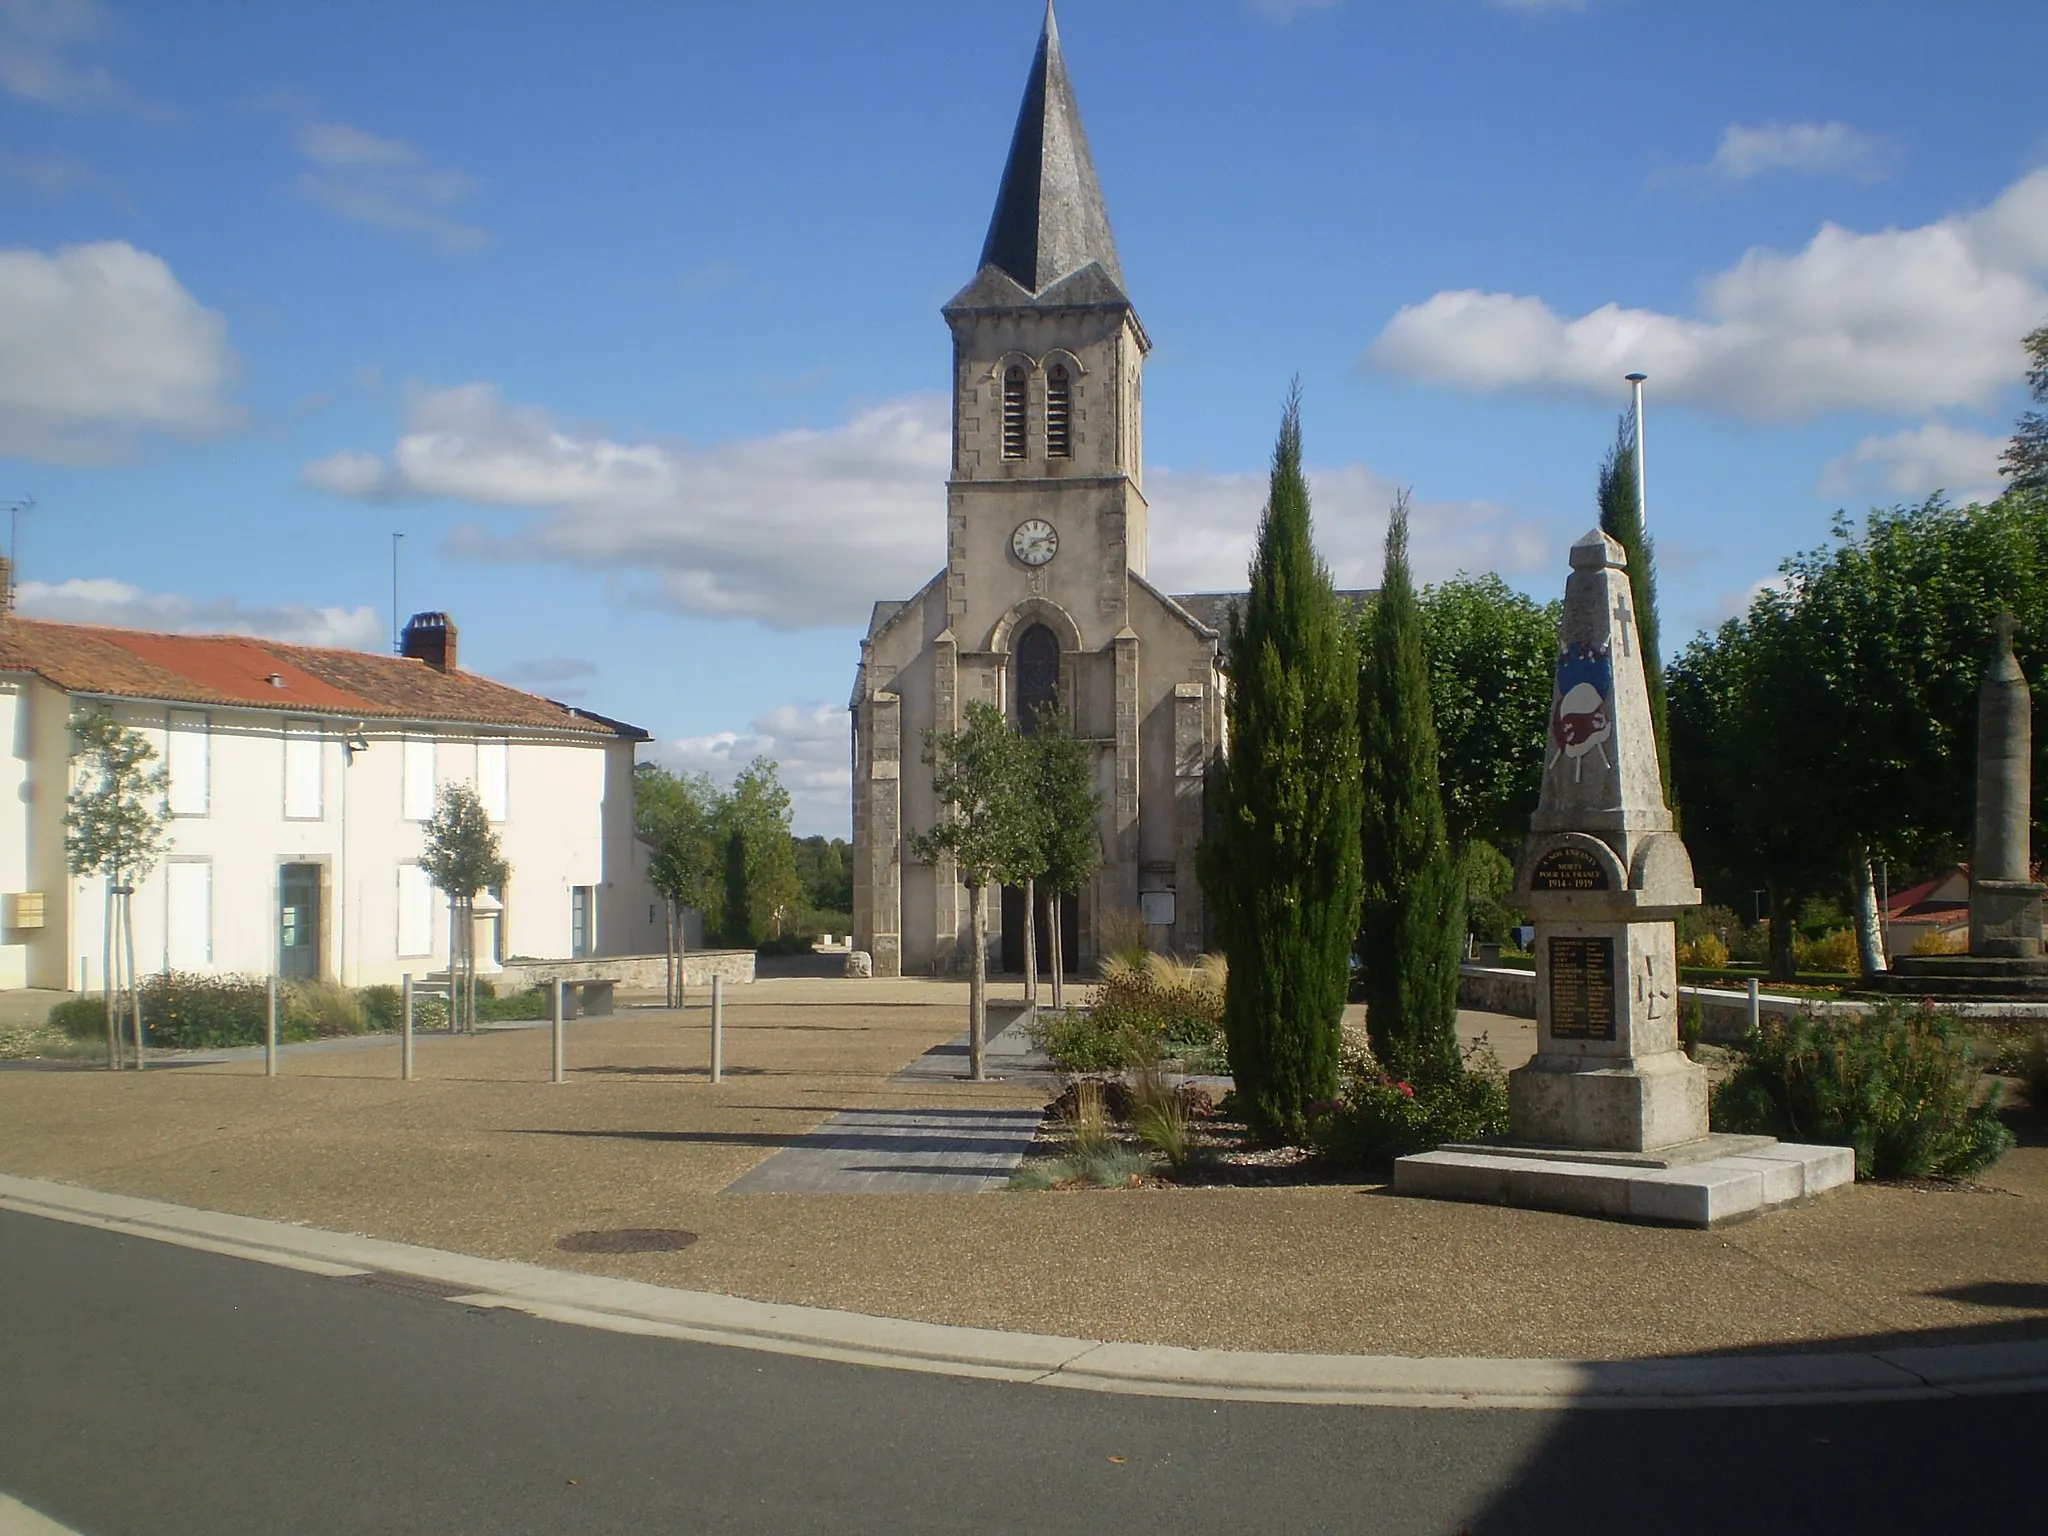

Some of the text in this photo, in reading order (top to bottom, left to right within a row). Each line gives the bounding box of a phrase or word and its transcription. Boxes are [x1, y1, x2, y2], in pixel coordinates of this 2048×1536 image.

[1566, 849, 1596, 866] ENFANTS
[1548, 879, 1566, 888] 1914
[1575, 879, 1593, 888] 1919
